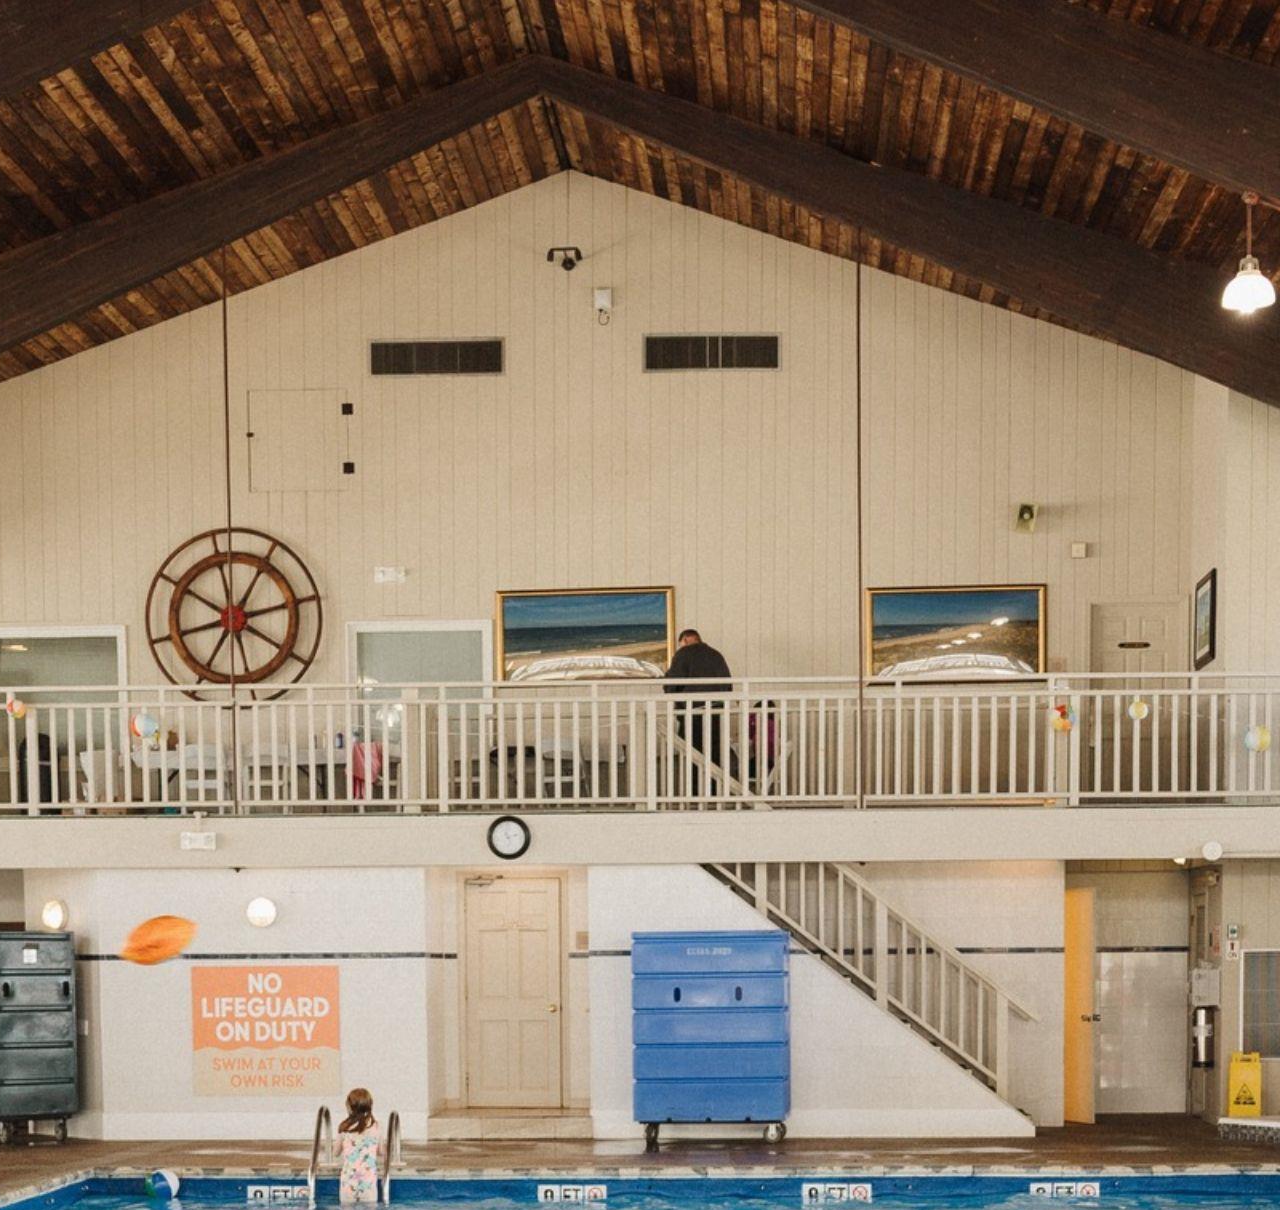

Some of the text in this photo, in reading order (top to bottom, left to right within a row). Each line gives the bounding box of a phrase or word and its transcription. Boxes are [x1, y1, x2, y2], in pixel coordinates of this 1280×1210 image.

[247, 973, 282, 994] NO
[201, 997, 330, 1018] LIFEGUARD
[215, 1021, 316, 1042] ON DUTY
[212, 1057, 321, 1071] SWIM AT YOUR
[230, 1075, 304, 1088] OWN RISK
